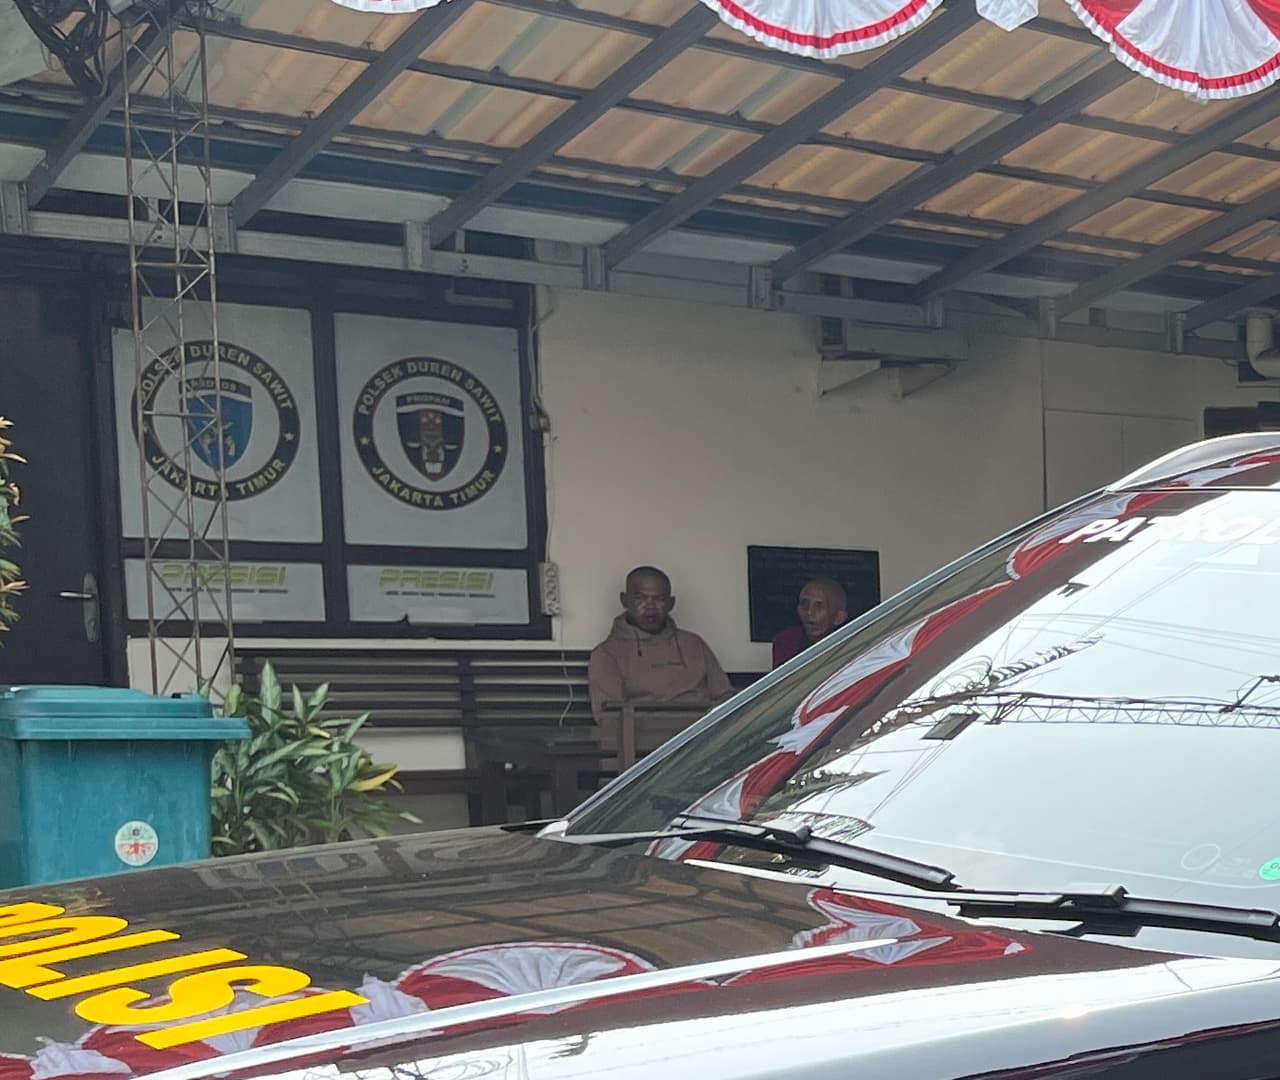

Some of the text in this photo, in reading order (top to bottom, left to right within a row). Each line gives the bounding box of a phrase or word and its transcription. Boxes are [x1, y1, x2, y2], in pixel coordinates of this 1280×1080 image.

[189, 344, 251, 366] DUREN
[253, 362, 294, 410] SAWIT
[358, 361, 501, 423] POLSEK DUREN SAWIT
[236, 458, 286, 496] TIMUR
[372, 466, 496, 507] JAKARTA TIMUR
